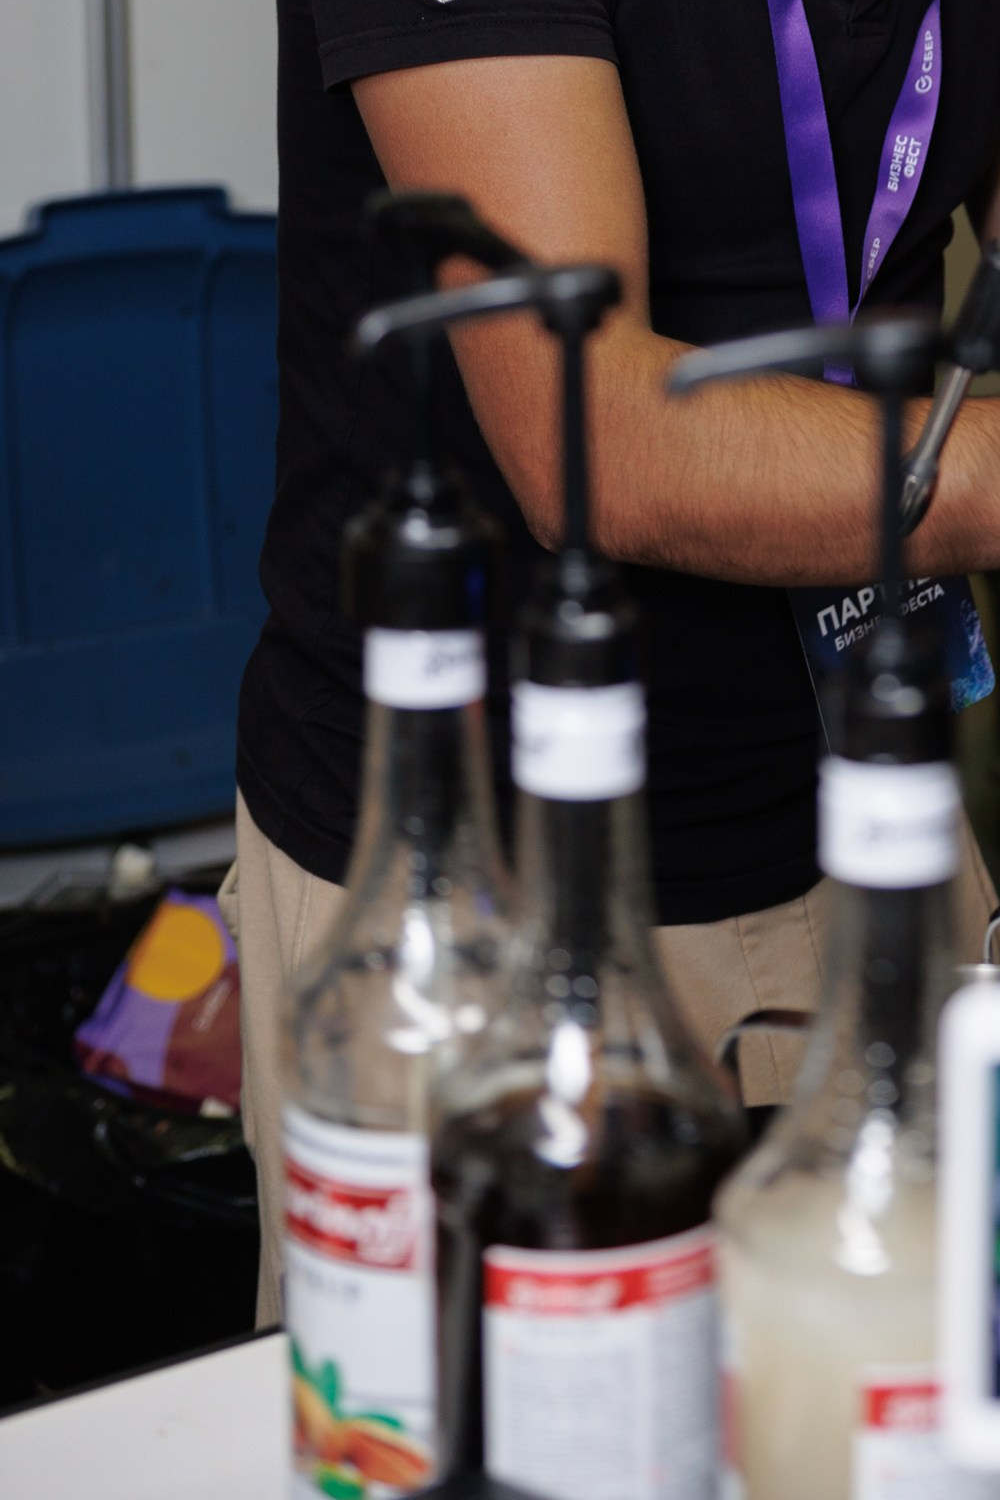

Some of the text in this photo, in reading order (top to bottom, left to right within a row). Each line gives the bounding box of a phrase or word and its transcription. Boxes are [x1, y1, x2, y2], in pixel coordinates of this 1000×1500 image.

[922, 30, 934, 73] СБЕР
[887, 133, 909, 193] БИЗНЕС
[903, 137, 923, 180] ФЕСТ
